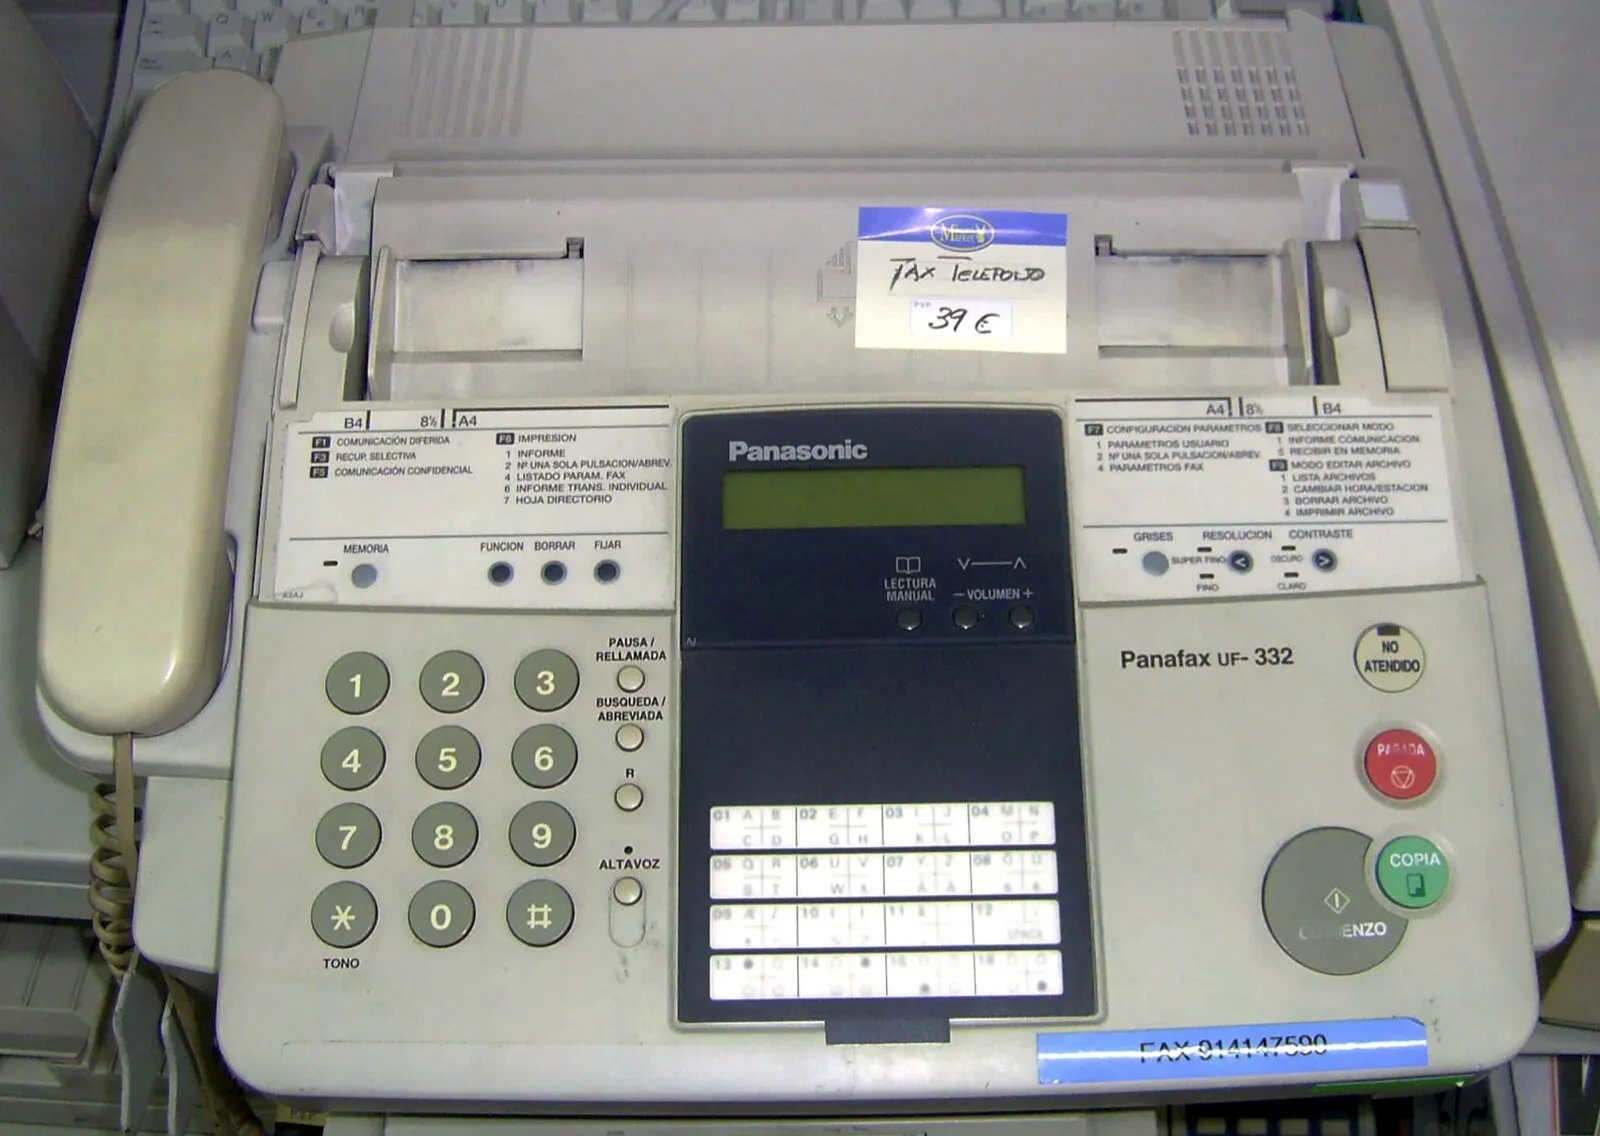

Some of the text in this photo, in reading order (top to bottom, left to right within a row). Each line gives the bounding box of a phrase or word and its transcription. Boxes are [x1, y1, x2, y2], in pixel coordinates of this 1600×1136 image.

[216, 13, 229, 25] Q
[262, 12, 274, 23] W
[928, 306, 968, 333] 39
[1205, 403, 1225, 416] A4
[1322, 402, 1342, 415] B4
[344, 417, 363, 429] B4
[458, 415, 477, 427] A4
[1287, 423, 1359, 432] SELECCIONAR
[1362, 422, 1394, 431] MODO
[1106, 424, 1191, 434] CONFIGURACION
[1193, 423, 1262, 433] PARAMETROS
[336, 435, 408, 447] COMUNICACIÓN
[409, 435, 450, 445] DIFERIDA
[518, 433, 577, 443] IMPRESION
[1288, 435, 1420, 445] INFORME COMUNICACION
[728, 439, 868, 462] Panasonic
[1108, 440, 1179, 450] PARAMETROS
[1182, 439, 1230, 448] USUARIO
[336, 453, 368, 462] RECUP.
[369, 452, 417, 461] SELECTIVA
[506, 449, 566, 459] 1 INFORME
[1121, 452, 1142, 460] UNA
[1144, 451, 1170, 460] SOLA
[1290, 447, 1332, 456] RECIBIR
[1334, 447, 1348, 455] EN
[1351, 446, 1401, 455] MEMORIA
[505, 461, 511, 470] 2
[530, 460, 551, 469] UNA
[552, 460, 578, 469] SOLA
[1109, 463, 1182, 473] PARAMETROS
[1184, 462, 1204, 472] FAX
[1291, 459, 1411, 469] MODO EDITAR ARCHIVO
[334, 466, 406, 477] COMUNICACIÓN
[407, 466, 473, 475] CONFIDENCIAL
[504, 470, 626, 482] 4 LISTADO PARAM. FAX
[1292, 473, 1376, 482] LISTA ARCHIVOS
[504, 482, 668, 493] 6 INFORME TRANS. INDIVIDUAL
[1293, 484, 1342, 494] CAMBIAR
[1344, 483, 1429, 493] HORA/ESTACION
[504, 494, 613, 505] 7 HOJA DIRECTORIO
[1295, 496, 1339, 505] BORRAR
[1342, 495, 1388, 504] ARCHIVO
[1348, 507, 1394, 516] ARCHIVO
[1133, 531, 1174, 542] GRISES
[1202, 530, 1273, 541] RESOLUCION
[1288, 529, 1353, 540] CONTRASTE
[343, 543, 390, 554] MEMORIA
[480, 541, 524, 553] FUNCION
[534, 541, 576, 552] BORRAR
[594, 540, 622, 551] FIJAR
[1171, 555, 1226, 565] SUPER FINO
[884, 577, 936, 590] LECTURA
[1196, 584, 1219, 592] FINO
[1277, 582, 1307, 591] CLARO
[886, 589, 935, 602] MANUAL
[967, 588, 1020, 600] VOLUMEN
[609, 637, 646, 648] PAUSA
[1381, 640, 1399, 654] NO
[595, 650, 667, 662] RELLAMADA
[1121, 648, 1211, 669] Panafax
[1254, 647, 1294, 667] 332
[1364, 659, 1420, 674] ATENDIDO
[349, 673, 362, 698] 1
[441, 672, 460, 697] 2
[536, 671, 555, 695] 3
[596, 697, 657, 708] BUSQUEDA
[598, 710, 664, 722] ABREVIADA
[341, 748, 362, 773] 4
[437, 747, 458, 772] 5
[534, 746, 554, 771] 6
[625, 768, 635, 779] R
[713, 809, 730, 821] 01
[800, 807, 817, 820] 02
[944, 806, 951, 818] J
[971, 805, 989, 817] 04
[338, 825, 357, 850] 7
[434, 825, 454, 850] 8
[531, 823, 552, 849] 9
[858, 834, 868, 844] H
[944, 832, 952, 844] L
[1001, 830, 1040, 843] O P
[599, 859, 661, 871] ALTAVOZ
[743, 857, 754, 870] Q
[800, 855, 868, 869] 06 U V
[887, 855, 903, 868] 07
[1390, 853, 1441, 868] COPIA
[772, 883, 780, 895] T
[830, 883, 845, 895] W
[802, 907, 819, 919] 10
[890, 905, 904, 916] 11
[976, 903, 993, 916] 12
[430, 904, 452, 931] 0
[1299, 921, 1387, 941] CENZO
[323, 958, 360, 970] TONO
[1140, 1041, 1191, 1063] FAX
